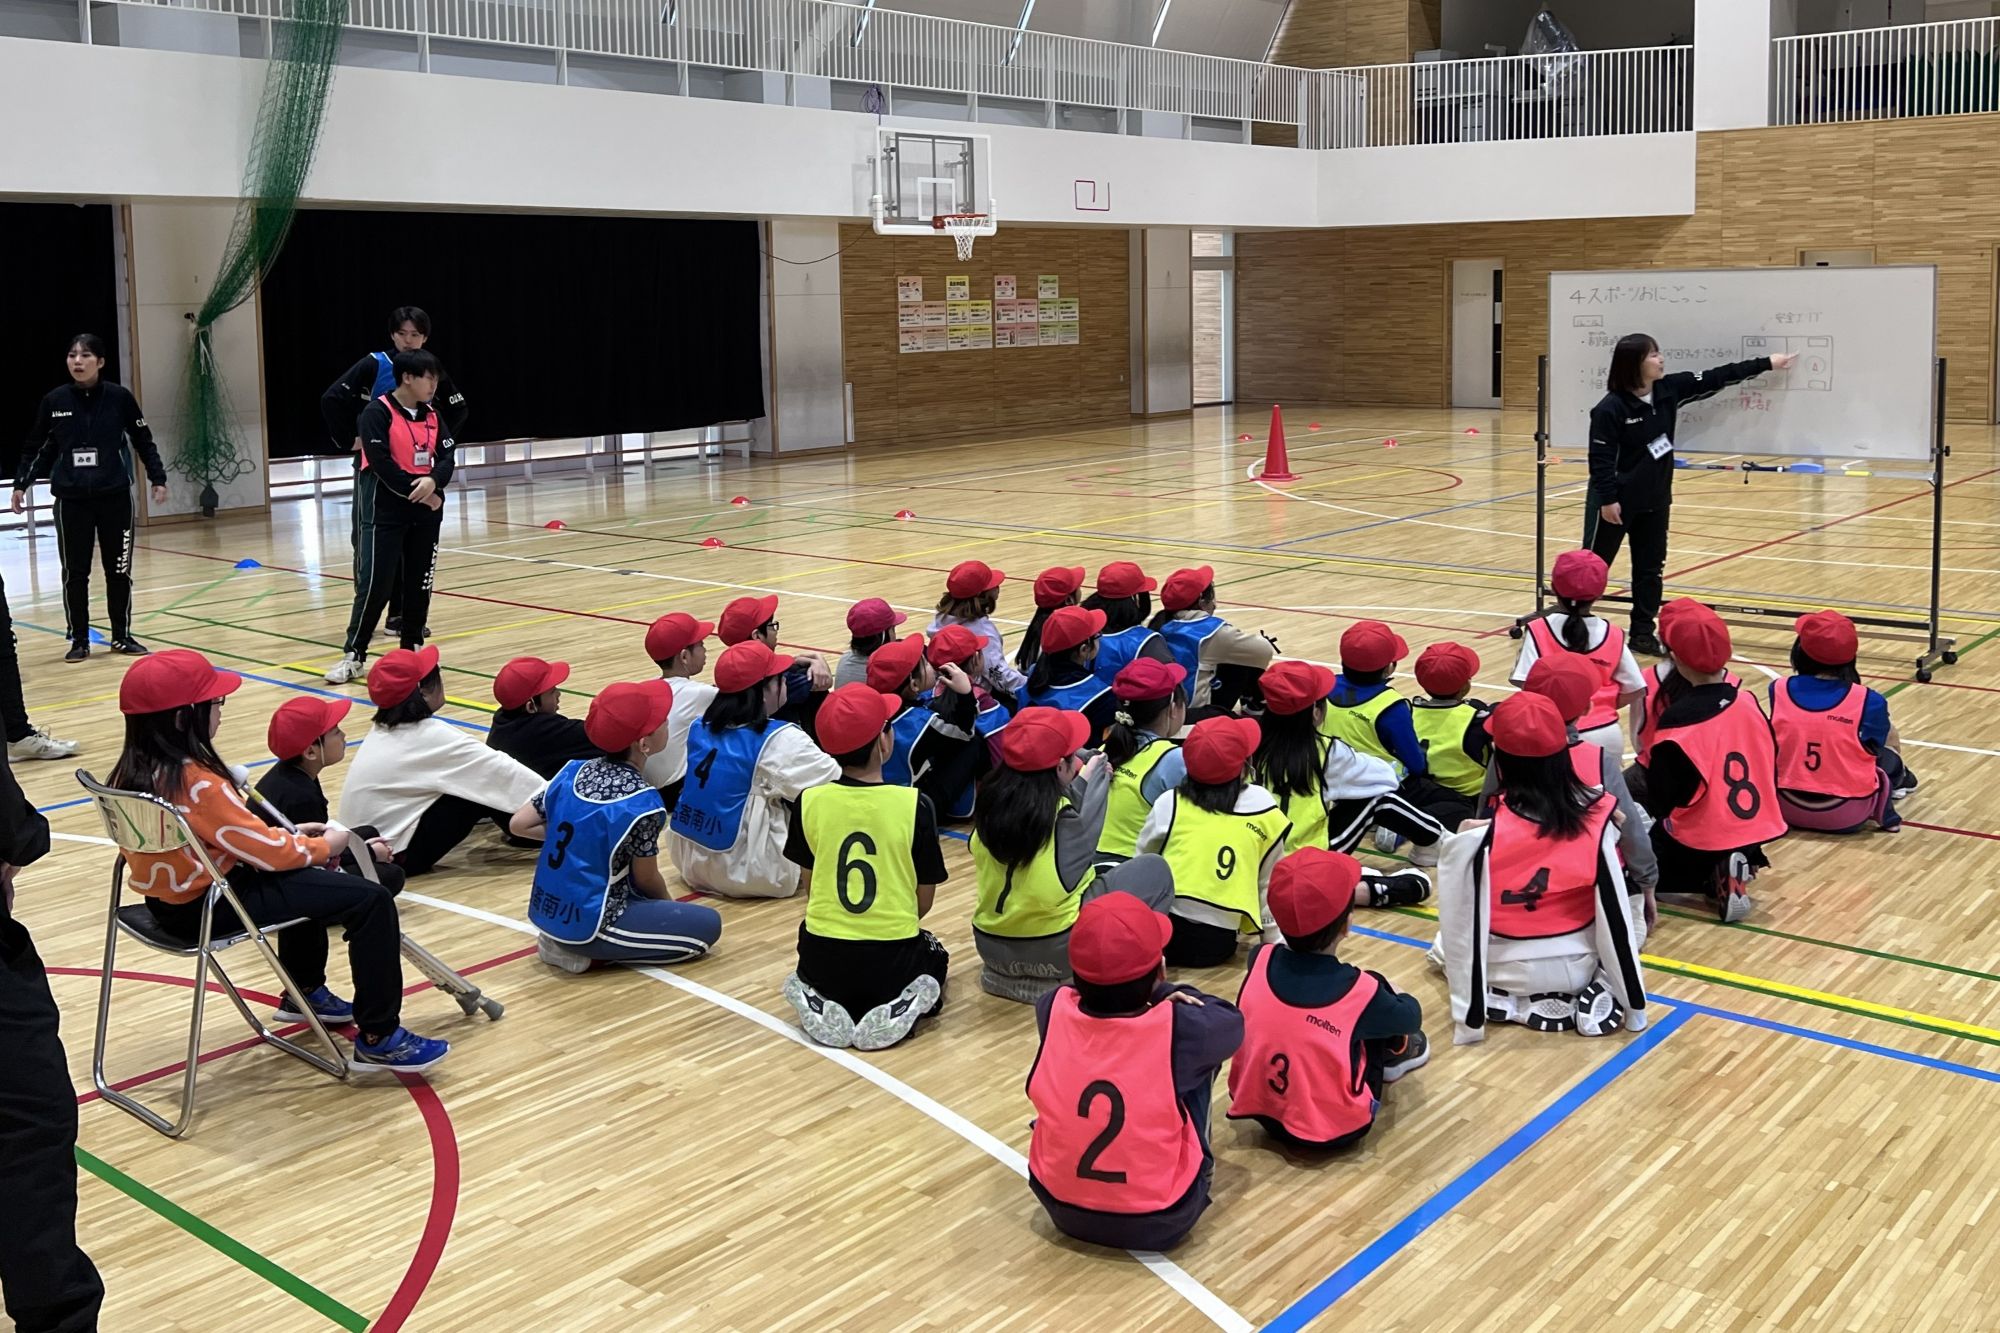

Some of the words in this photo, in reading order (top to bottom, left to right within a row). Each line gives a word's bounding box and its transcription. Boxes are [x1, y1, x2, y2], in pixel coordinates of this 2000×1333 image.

[694, 747, 719, 789] 4
[1804, 741, 1822, 772] 5
[1723, 751, 1760, 820] 8
[548, 821, 574, 871] 3
[1246, 822, 1268, 841] molten
[835, 830, 878, 914] 6
[1215, 844, 1237, 881] 9
[1500, 867, 1551, 913] 4
[1305, 1013, 1342, 1038] molten
[1269, 1052, 1290, 1096] 3
[1075, 1079, 1128, 1185] 2
